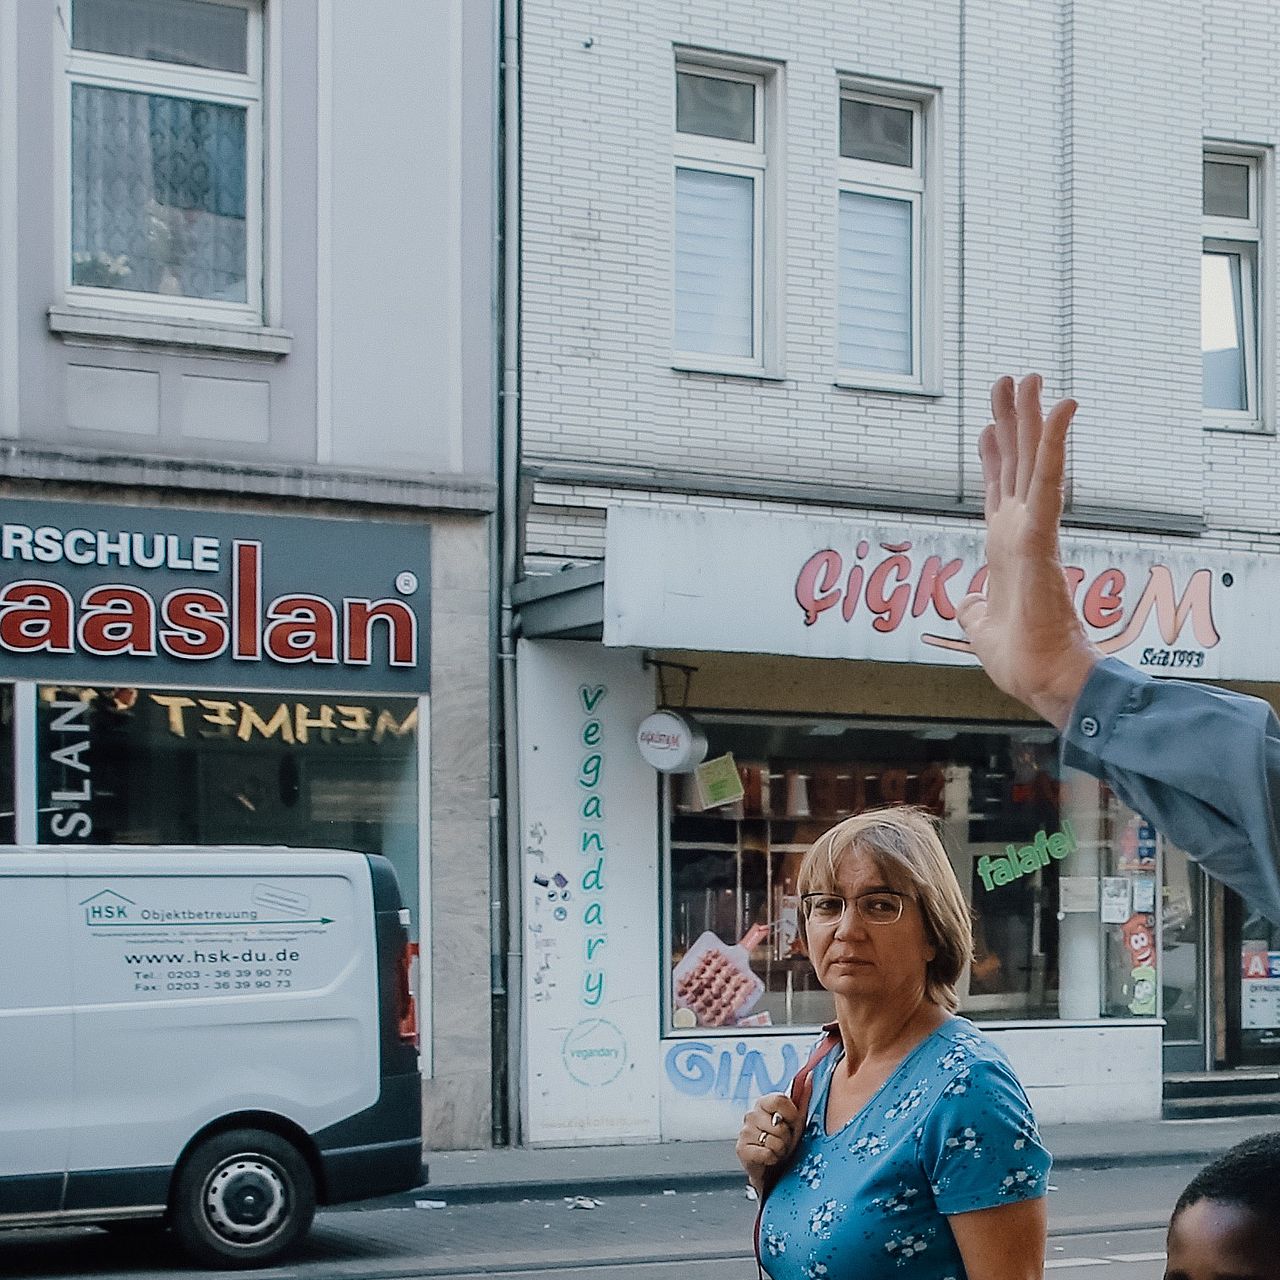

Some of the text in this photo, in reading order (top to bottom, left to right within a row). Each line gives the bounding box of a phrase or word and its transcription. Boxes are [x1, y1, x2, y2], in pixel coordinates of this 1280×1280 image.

[0, 523, 221, 573] RSCHULE
[0, 539, 418, 667] aaslan
[976, 819, 1077, 892] falafel
[91, 906, 258, 922] HSK Objektbetreuung
[124, 948, 300, 966] www.hsk-du.de
[167, 969, 201, 980] 0203
[255, 968, 272, 978] 90
[276, 968, 293, 978] 70
[166, 980, 200, 991] 0203
[255, 980, 272, 990] 90
